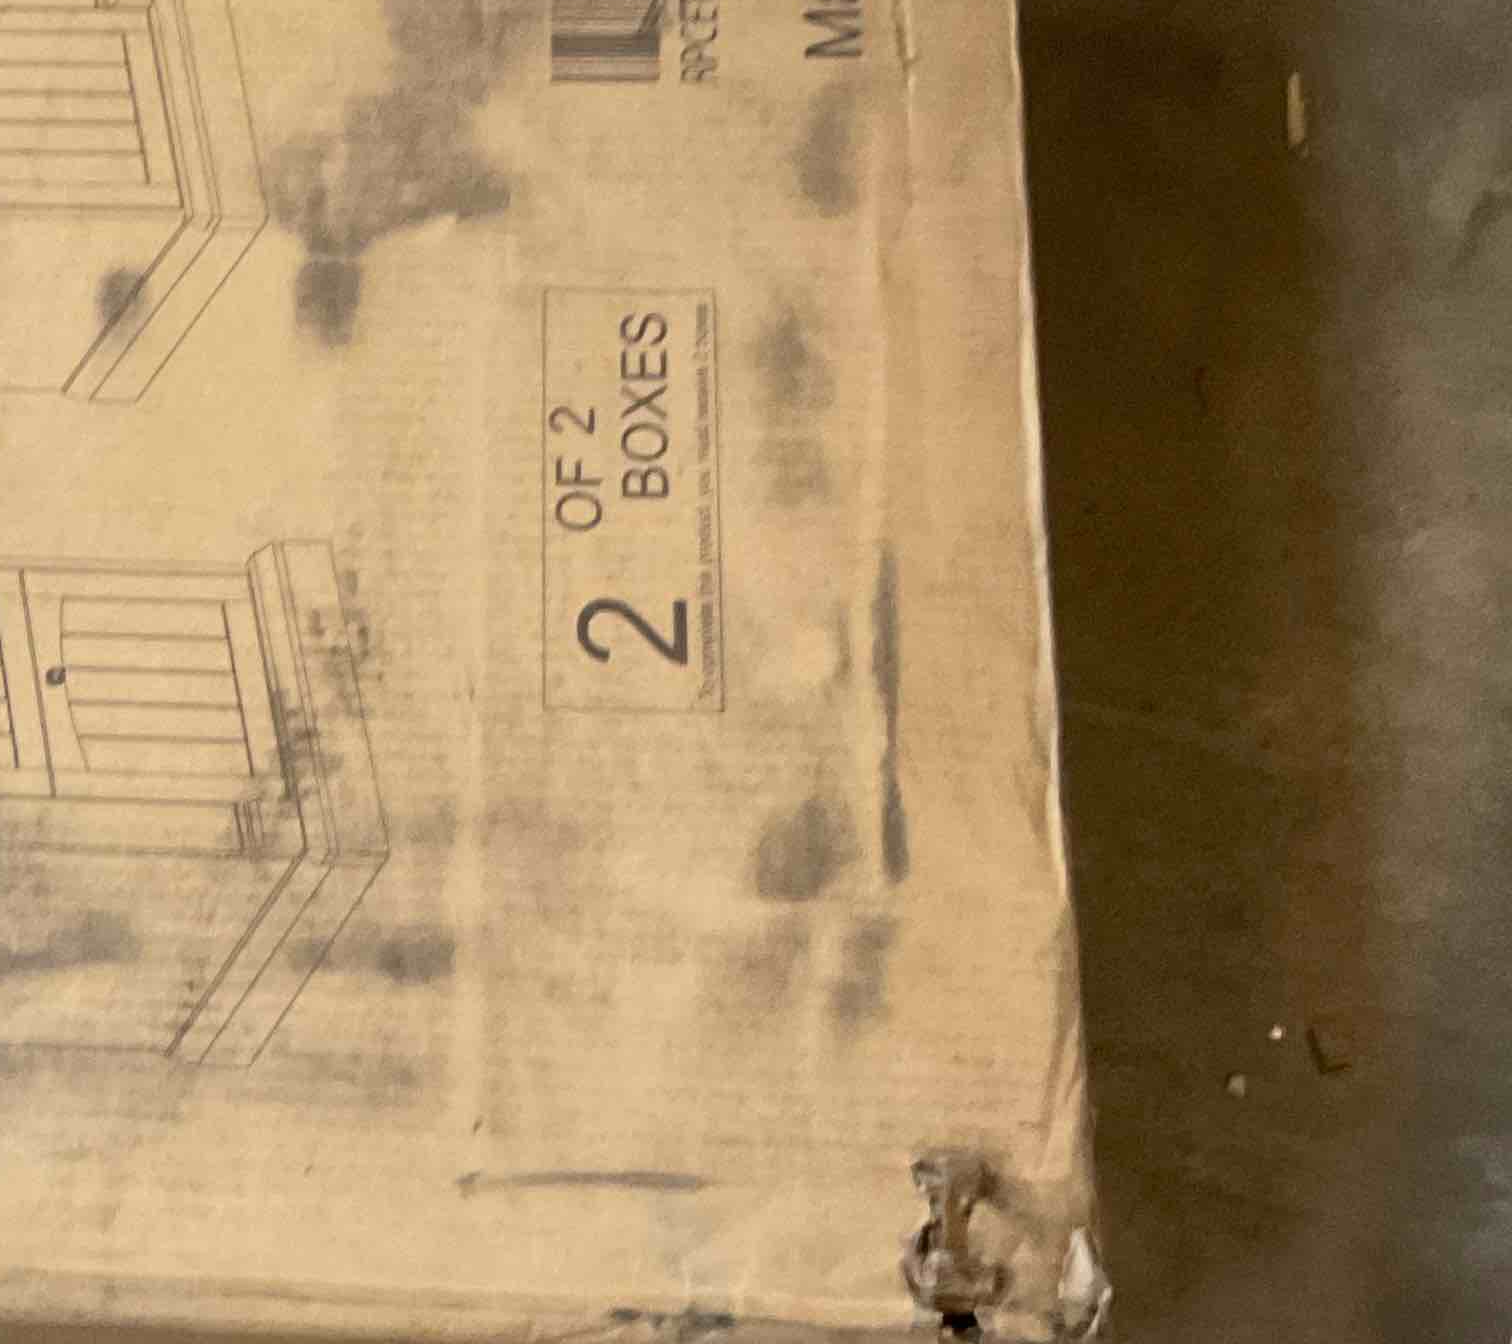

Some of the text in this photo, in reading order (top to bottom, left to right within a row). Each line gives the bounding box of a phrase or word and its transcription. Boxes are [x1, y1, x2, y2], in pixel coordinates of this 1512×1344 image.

[549, 405, 603, 532] OF 2
[620, 311, 669, 499] BOXES
[576, 598, 688, 665] 2
